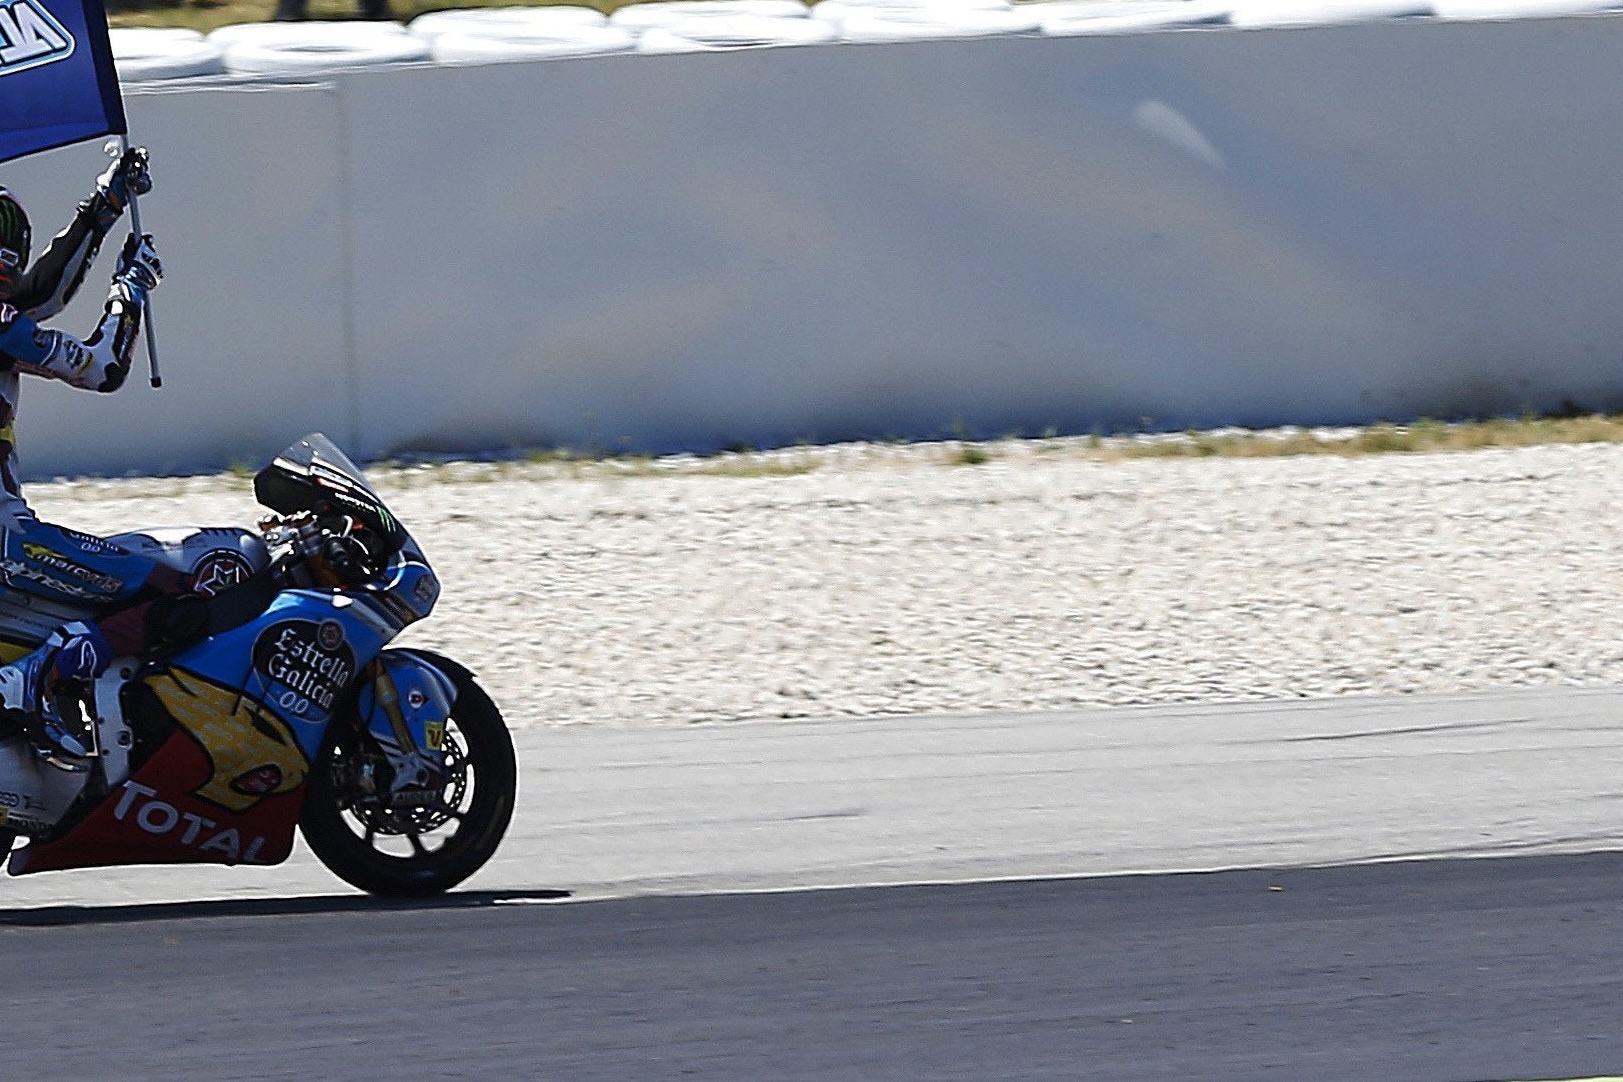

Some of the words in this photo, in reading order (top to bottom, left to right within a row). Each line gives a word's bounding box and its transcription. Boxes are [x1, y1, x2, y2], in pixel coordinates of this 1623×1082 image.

[268, 653, 334, 709] Galicia
[274, 628, 349, 687] Estrella
[113, 780, 270, 864] TOTAL
